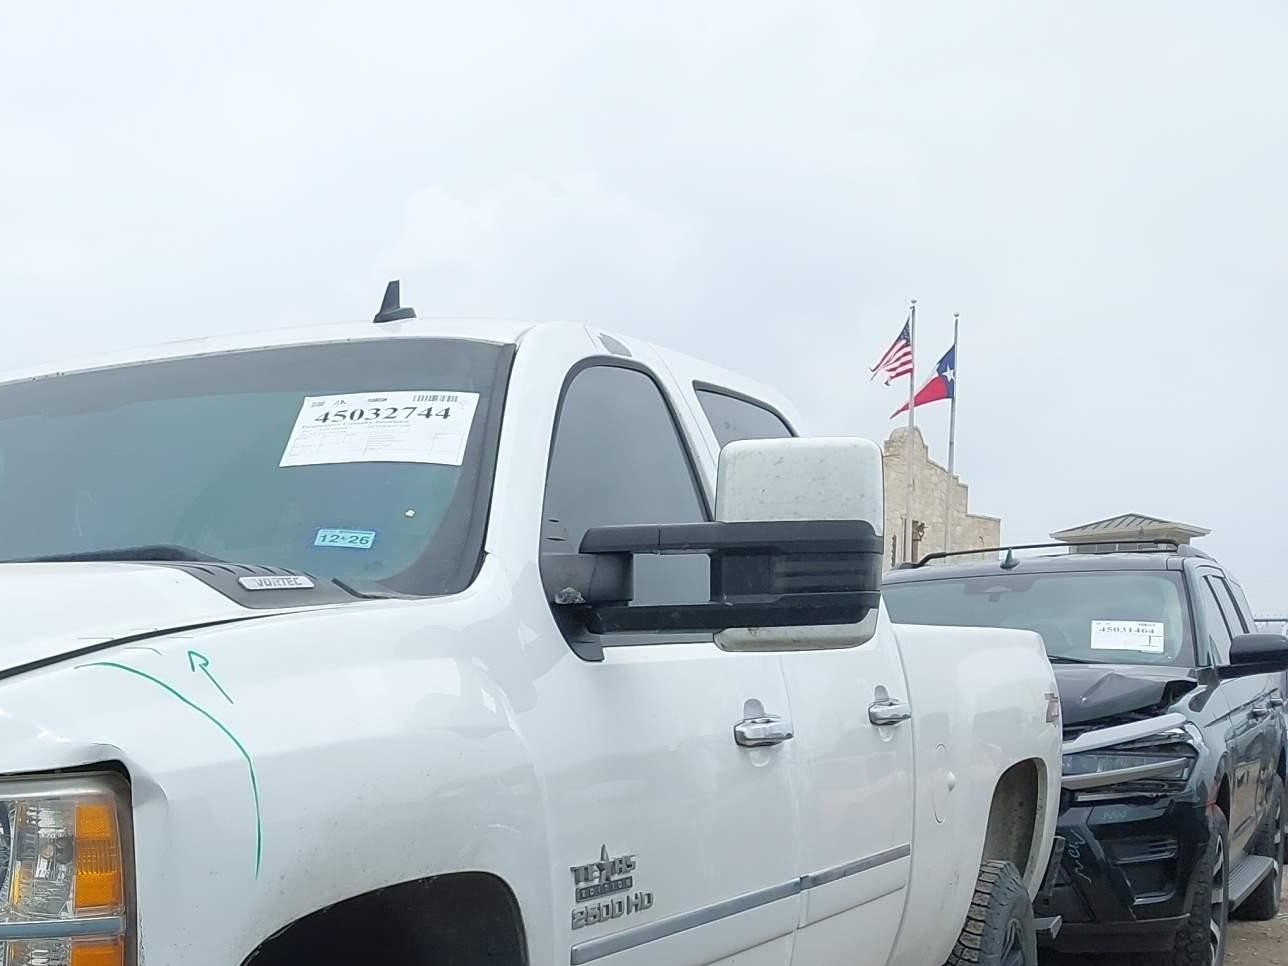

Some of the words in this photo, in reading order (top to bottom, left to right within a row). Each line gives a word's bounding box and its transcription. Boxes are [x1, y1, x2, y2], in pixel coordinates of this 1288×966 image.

[314, 406, 451, 424] 45032744
[320, 534, 340, 543] 12
[348, 535, 370, 545] 26
[255, 577, 304, 588] VORTEC
